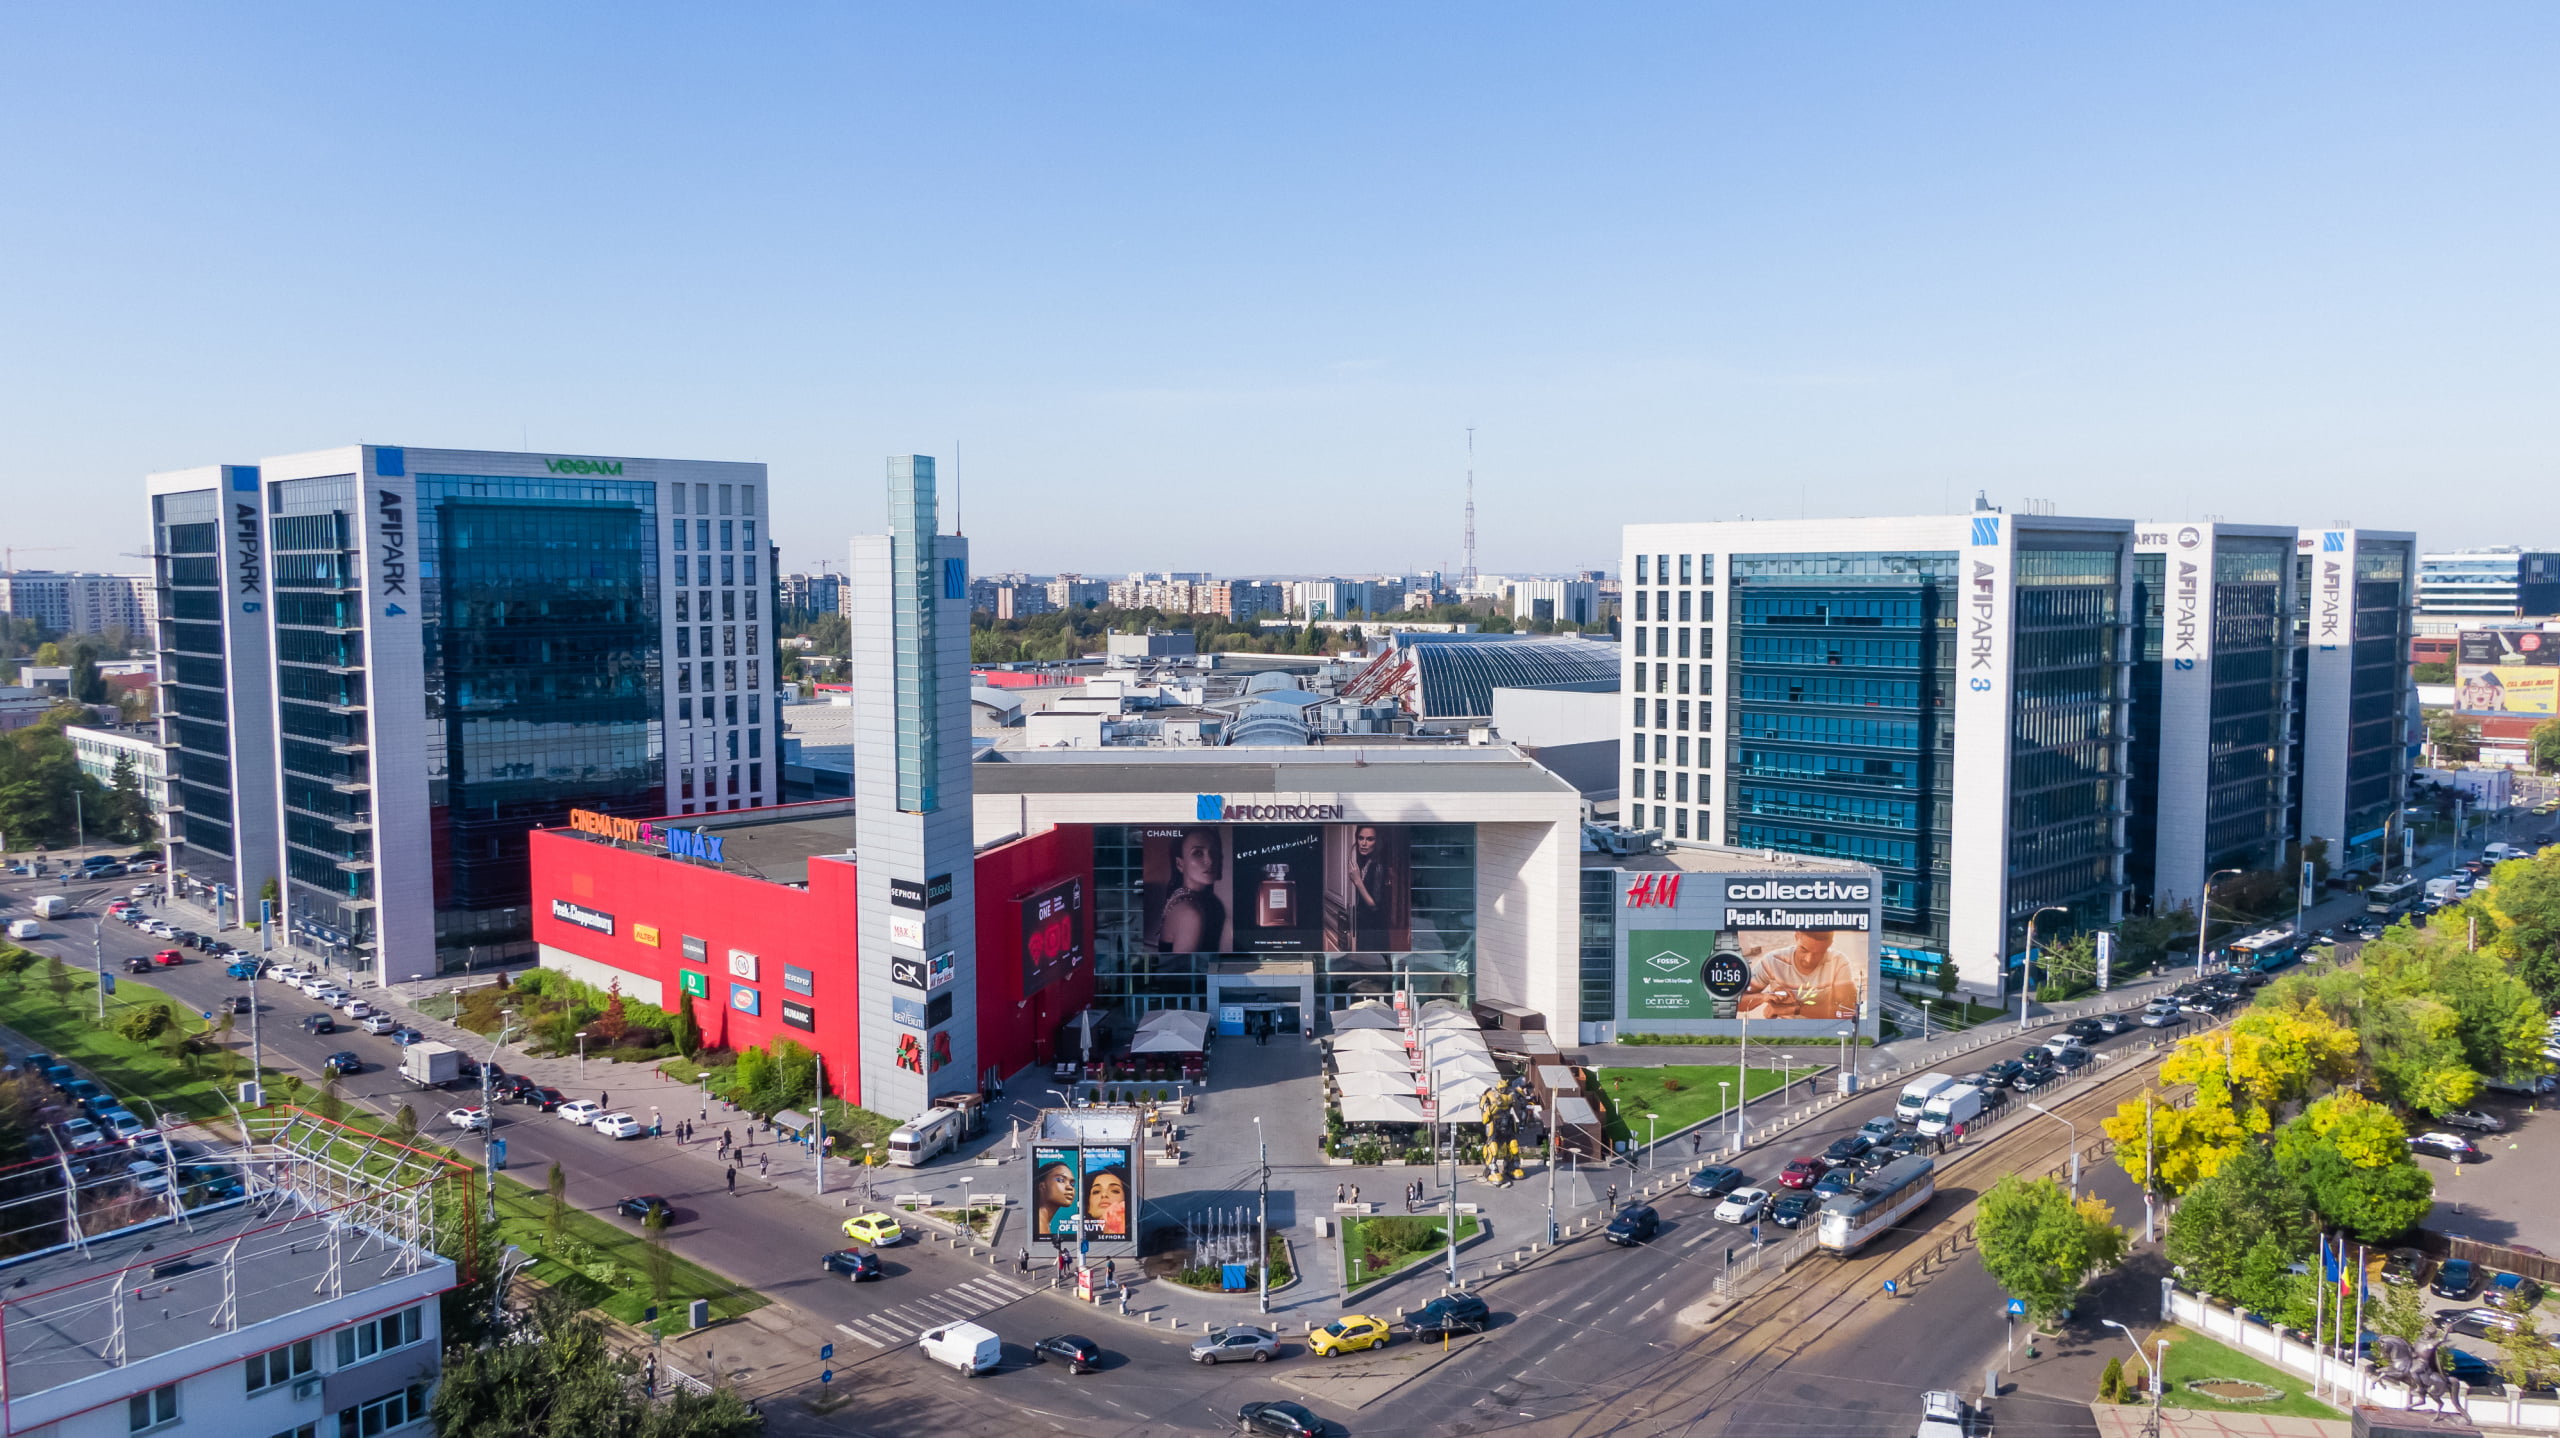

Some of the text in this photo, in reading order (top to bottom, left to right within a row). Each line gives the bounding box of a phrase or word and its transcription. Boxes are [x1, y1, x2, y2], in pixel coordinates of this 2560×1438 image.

[236, 503, 262, 613] AFIPARK 5
[379, 489, 407, 617] AFIPARK 4
[2174, 560, 2197, 671] AFIPARK 2
[2319, 561, 2341, 653] AFIPARK 1
[1970, 559, 1994, 692] AFIPARK 3
[667, 828, 725, 863] IMAX
[891, 888, 921, 901] SEPHORA
[929, 882, 951, 898] DOUGLAS
[1626, 873, 1681, 909] H&M
[1727, 880, 1869, 900] collective
[1039, 904, 1051, 920] ONE
[1710, 969, 1741, 982] 10:56
[784, 1006, 809, 1023] HUMANIC
